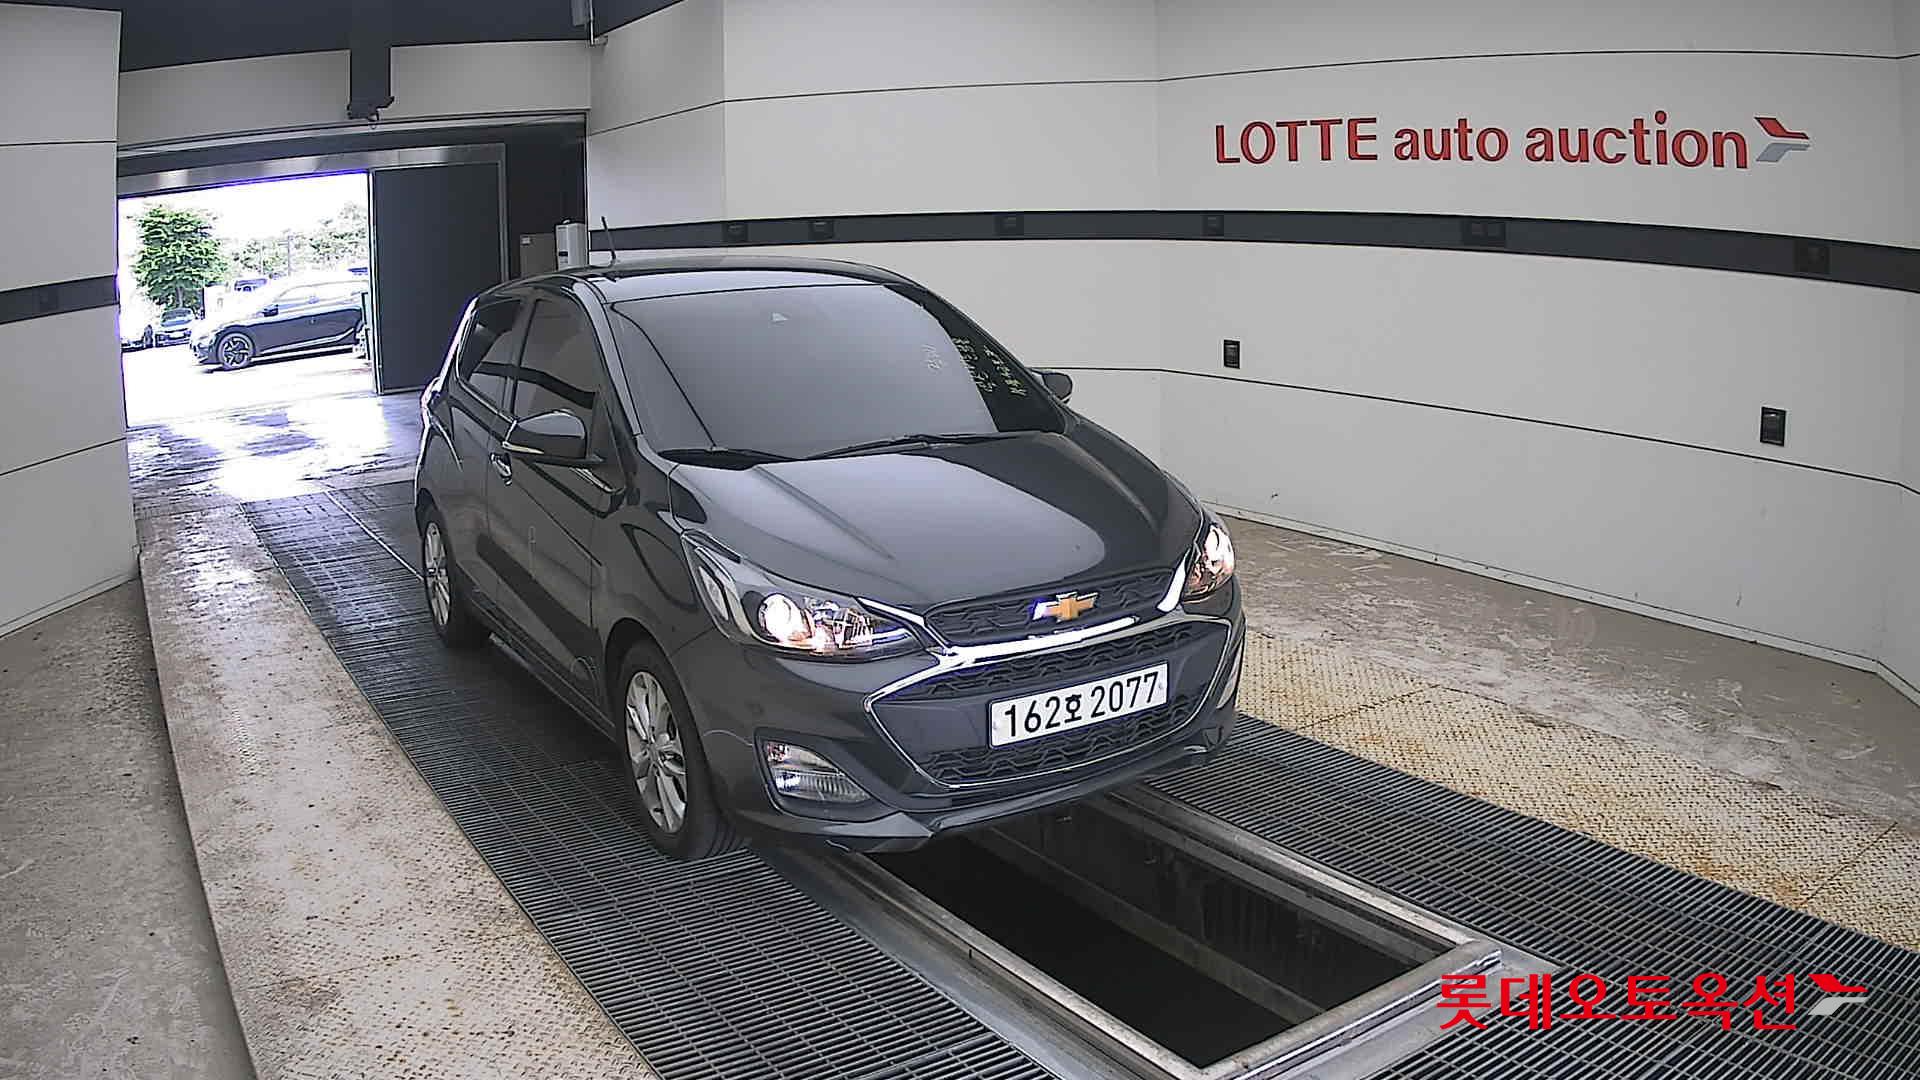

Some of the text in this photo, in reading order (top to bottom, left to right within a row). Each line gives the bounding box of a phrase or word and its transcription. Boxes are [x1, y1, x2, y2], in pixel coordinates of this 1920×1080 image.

[1215, 110, 1749, 169] LOTTE auto auction
[1004, 671, 1159, 737] 162호 2077
